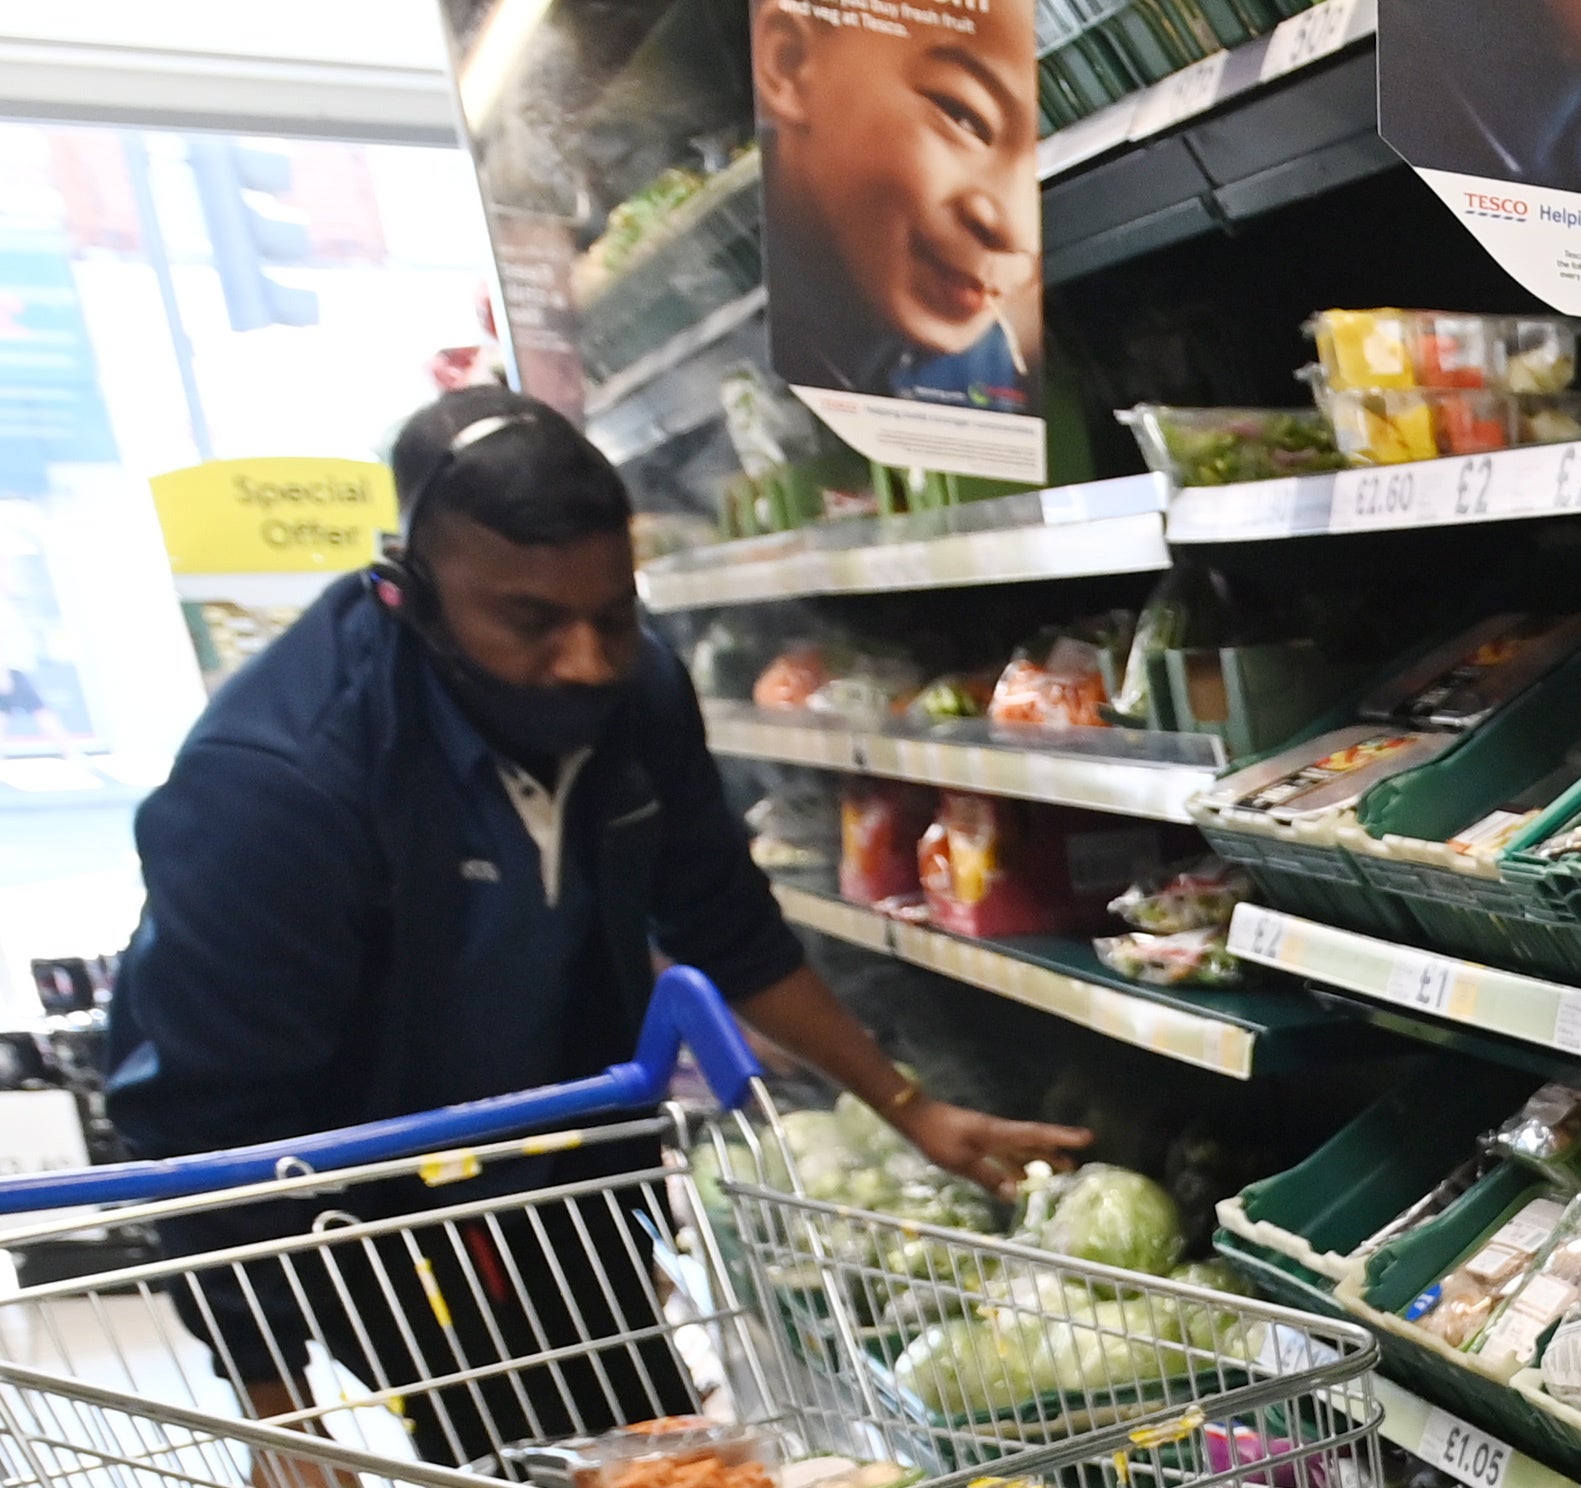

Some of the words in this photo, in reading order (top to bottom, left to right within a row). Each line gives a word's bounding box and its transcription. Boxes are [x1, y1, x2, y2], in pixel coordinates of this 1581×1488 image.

[1464, 192, 1529, 215] TESCO
[233, 474, 371, 512] Special
[1456, 455, 1494, 515] £2
[260, 518, 360, 549] Offer
[1417, 961, 1449, 1010] £1
[1442, 1426, 1503, 1487] £1.05
